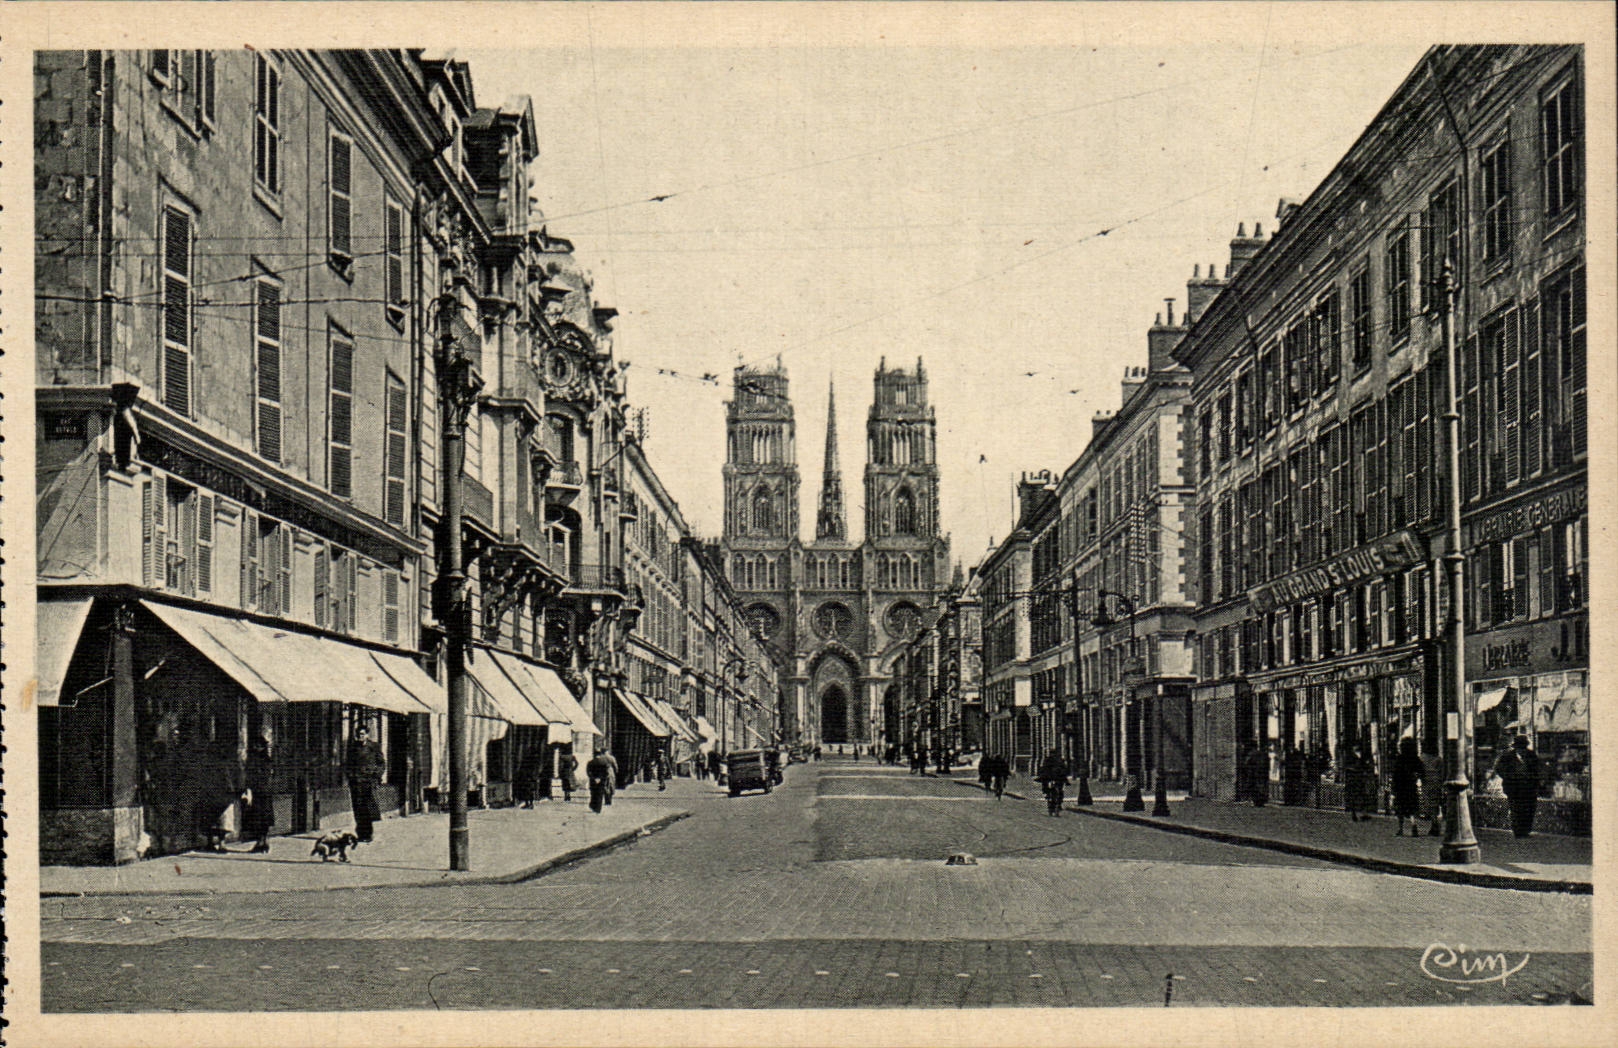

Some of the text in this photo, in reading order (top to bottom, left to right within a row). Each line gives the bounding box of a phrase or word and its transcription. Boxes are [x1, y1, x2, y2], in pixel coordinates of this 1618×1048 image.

[1271, 580, 1290, 604] AU
[1288, 567, 1330, 598] GRAND
[1339, 546, 1385, 580] LOUIS
